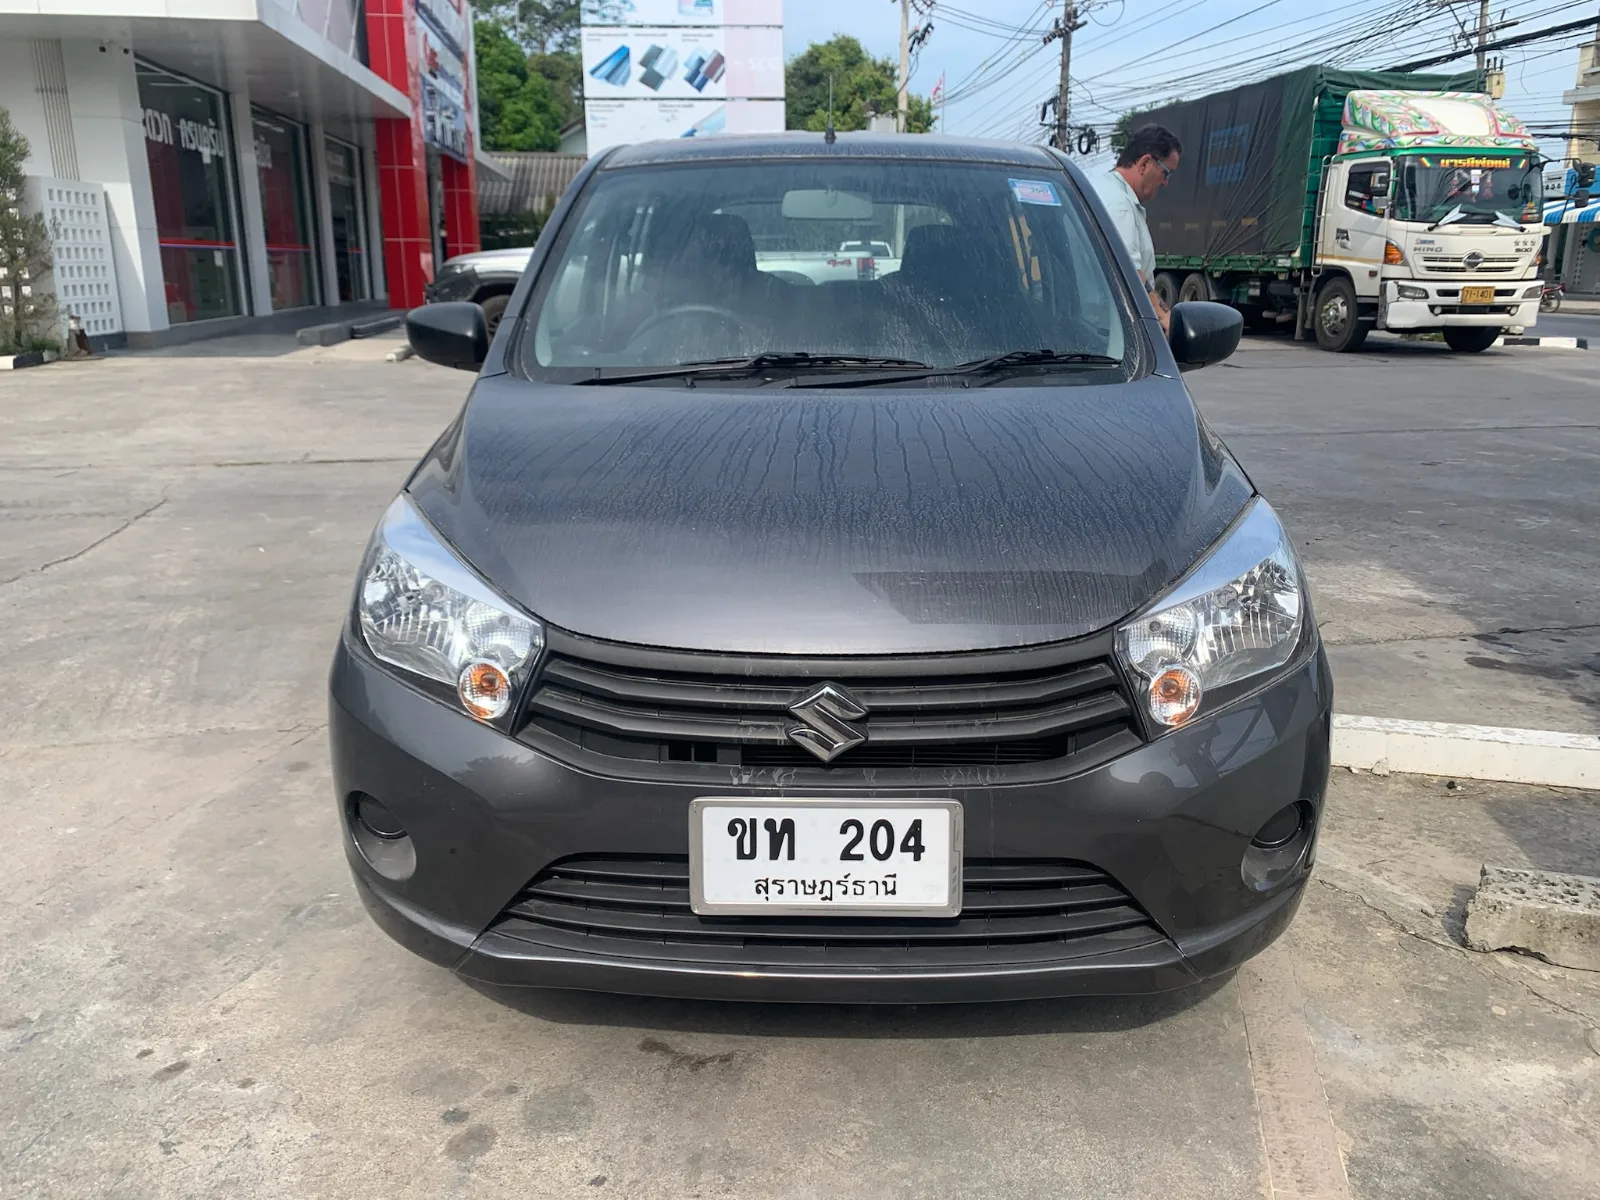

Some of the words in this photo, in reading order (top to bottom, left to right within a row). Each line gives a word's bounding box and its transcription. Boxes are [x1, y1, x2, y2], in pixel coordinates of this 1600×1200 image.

[727, 817, 796, 861] ขท
[839, 818, 926, 862] 204
[754, 872, 898, 901] สุราษฎร์ธานี
